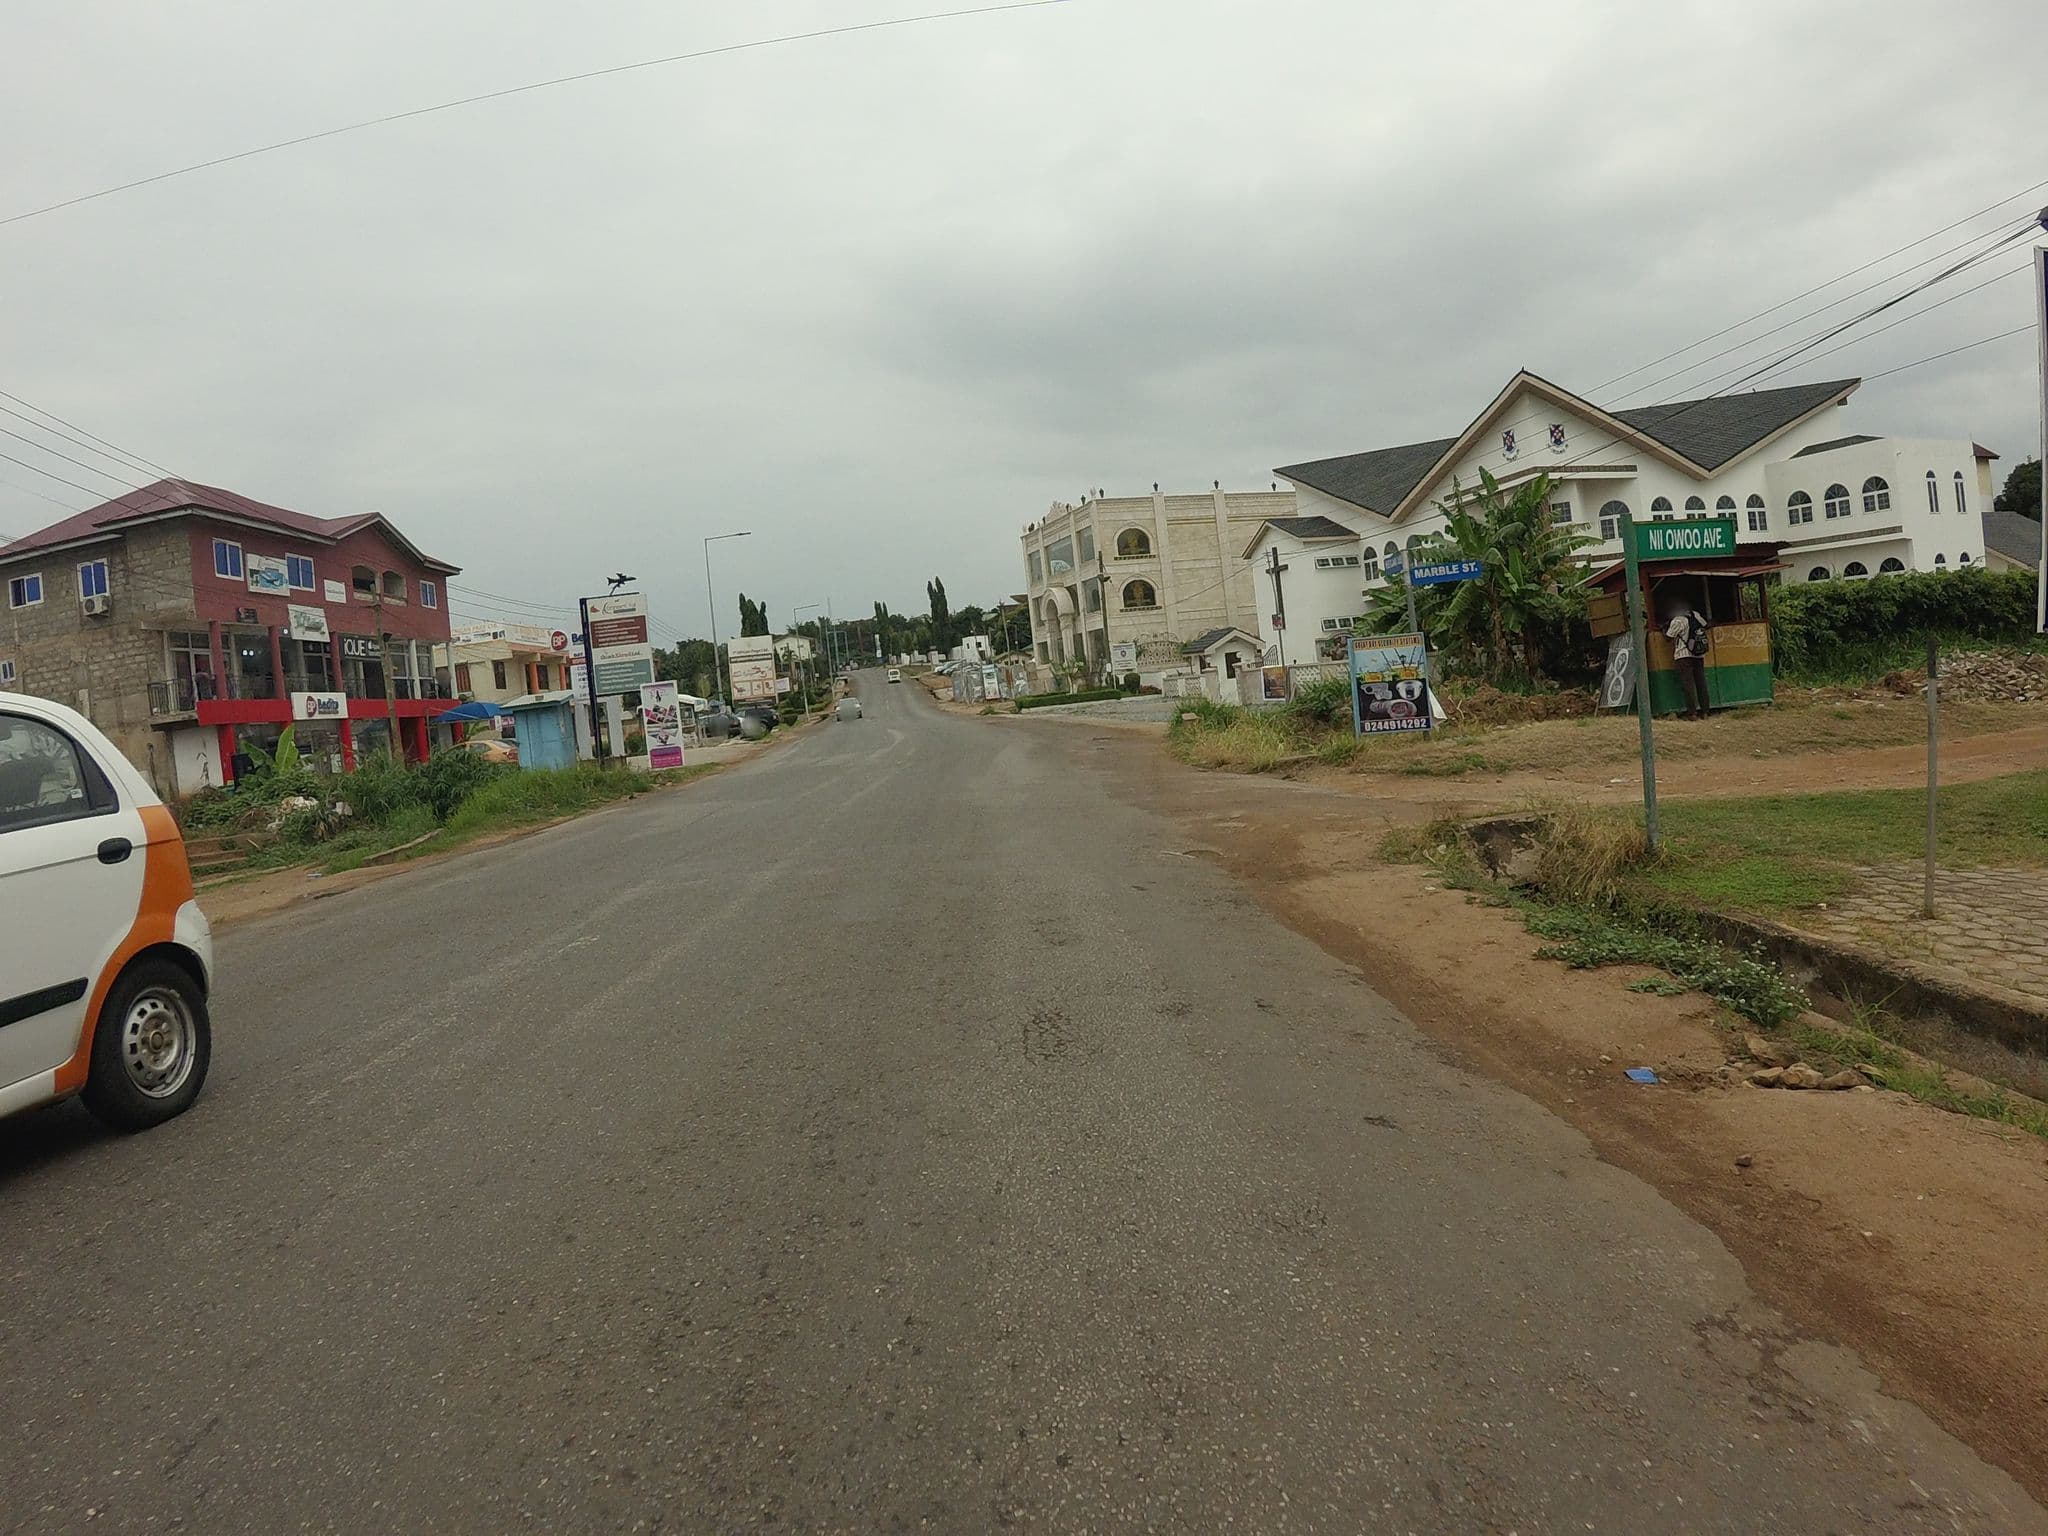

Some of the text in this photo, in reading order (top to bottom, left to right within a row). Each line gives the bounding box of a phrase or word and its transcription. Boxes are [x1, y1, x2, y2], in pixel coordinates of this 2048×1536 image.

[1649, 527, 1726, 550] NII OWOO AVE.
[1414, 561, 1478, 579] MARBLE ST.
